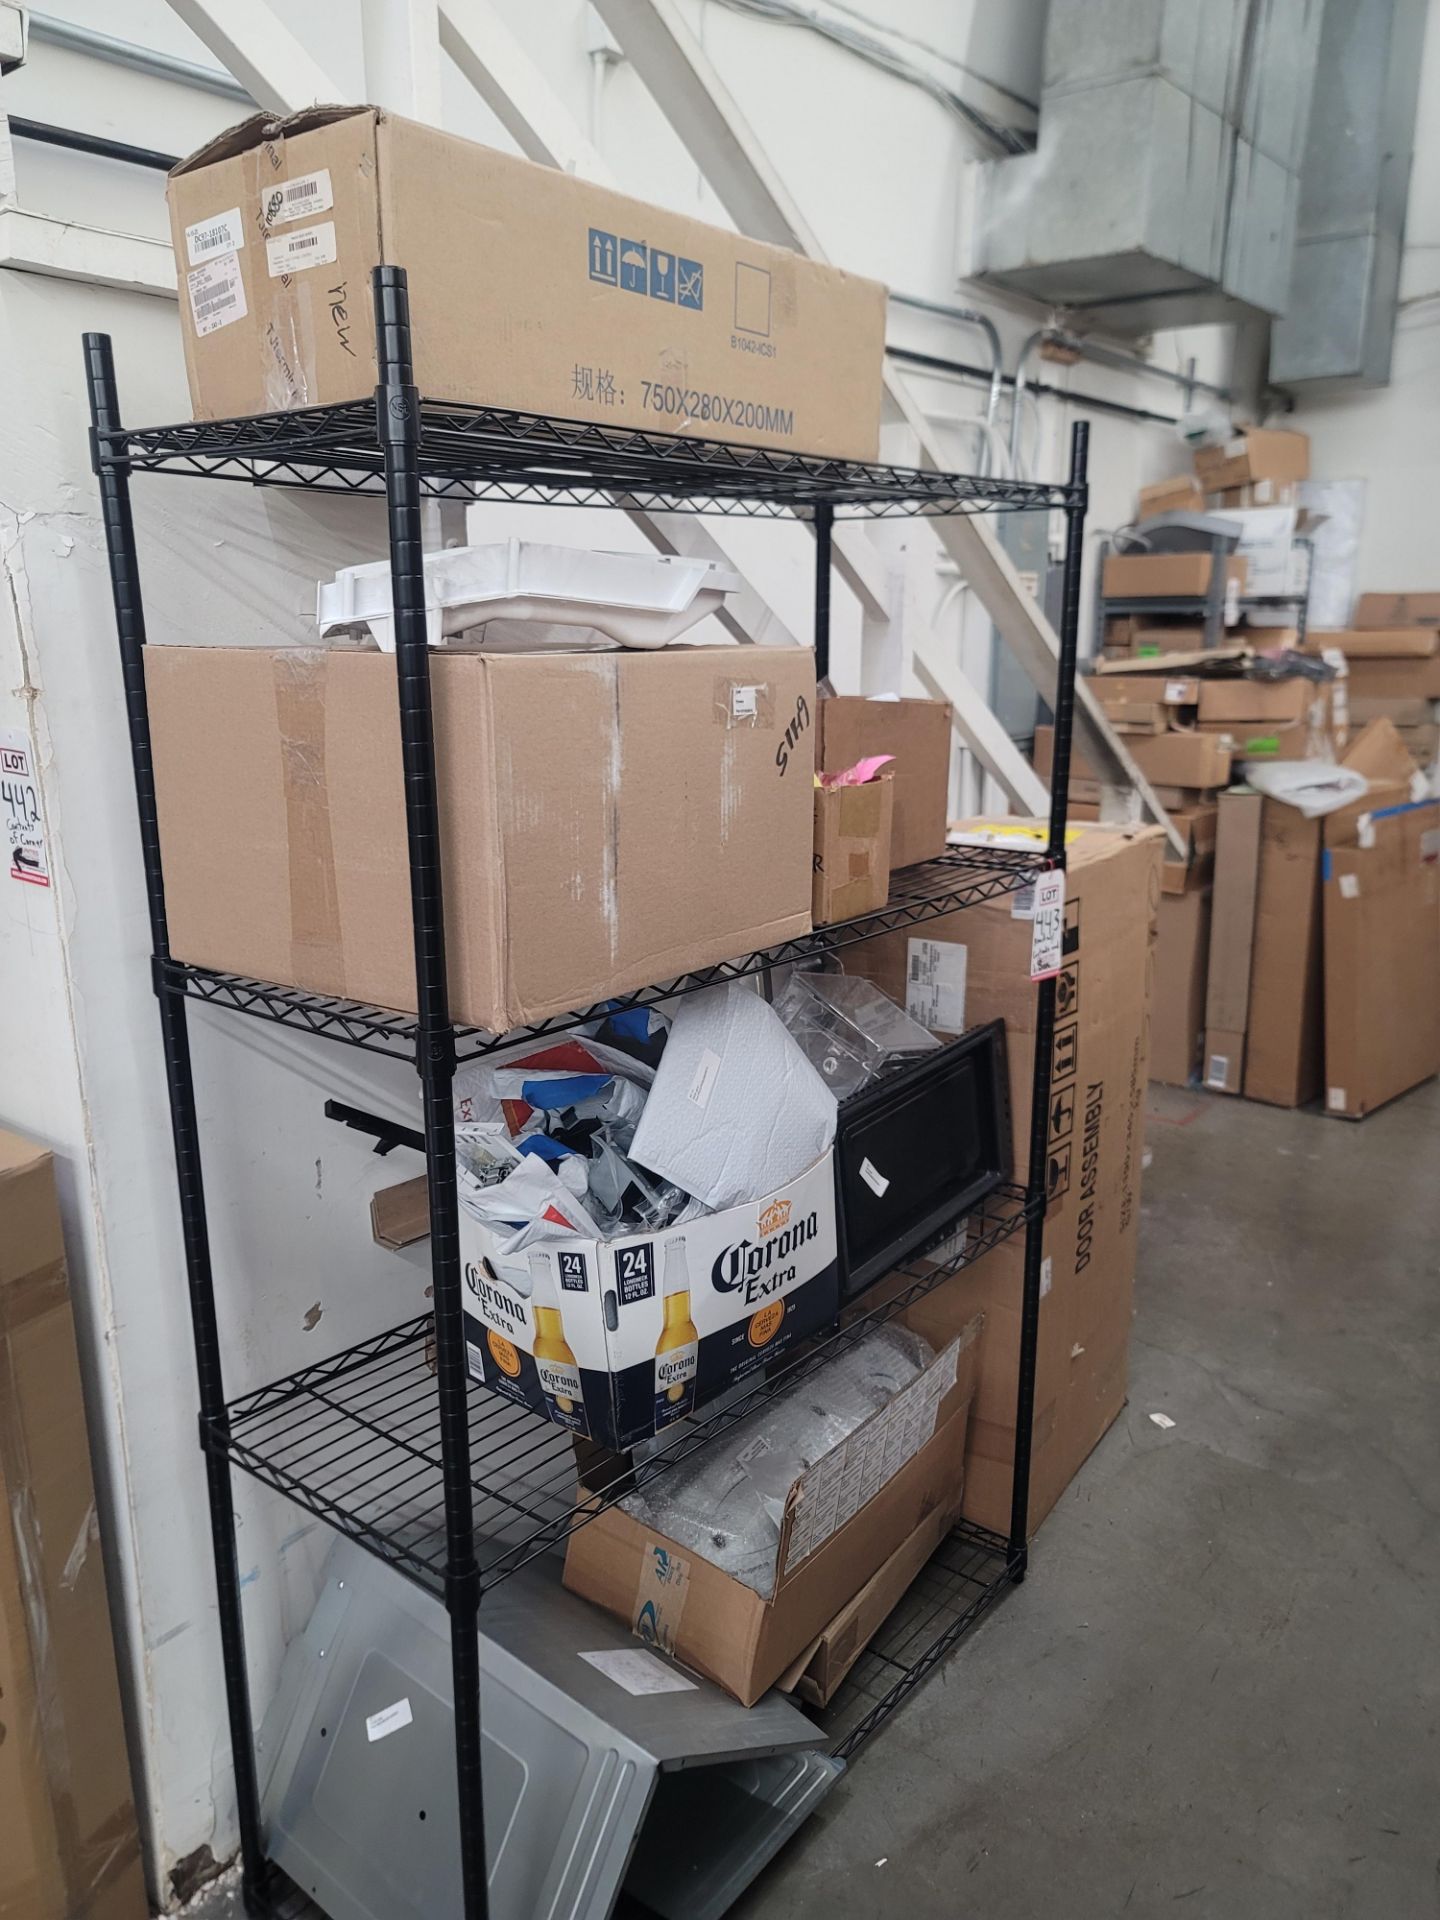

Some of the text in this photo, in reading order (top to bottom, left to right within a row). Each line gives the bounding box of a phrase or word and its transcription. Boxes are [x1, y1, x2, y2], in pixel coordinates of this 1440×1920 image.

[641, 380, 794, 436] 750X280X200MM
[4, 753, 25, 771] LOT
[1, 780, 41, 823] 442
[1041, 888, 1057, 902] LOT
[1035, 908, 1060, 936] 443
[1074, 1080, 1104, 1275] DOOR ASSEMBLY
[563, 1255, 581, 1274] 24
[622, 1249, 647, 1279] 24
[711, 1210, 819, 1294] Corona
[465, 1261, 527, 1326] Corona
[624, 1280, 649, 1294] BOTTLES
[625, 1292, 632, 1300] 12
[743, 1265, 797, 1307] Extra
[481, 1298, 515, 1336] Extra
[540, 1368, 579, 1390] Corona
[658, 1355, 695, 1380] Corona
[666, 1371, 687, 1385] Extra
